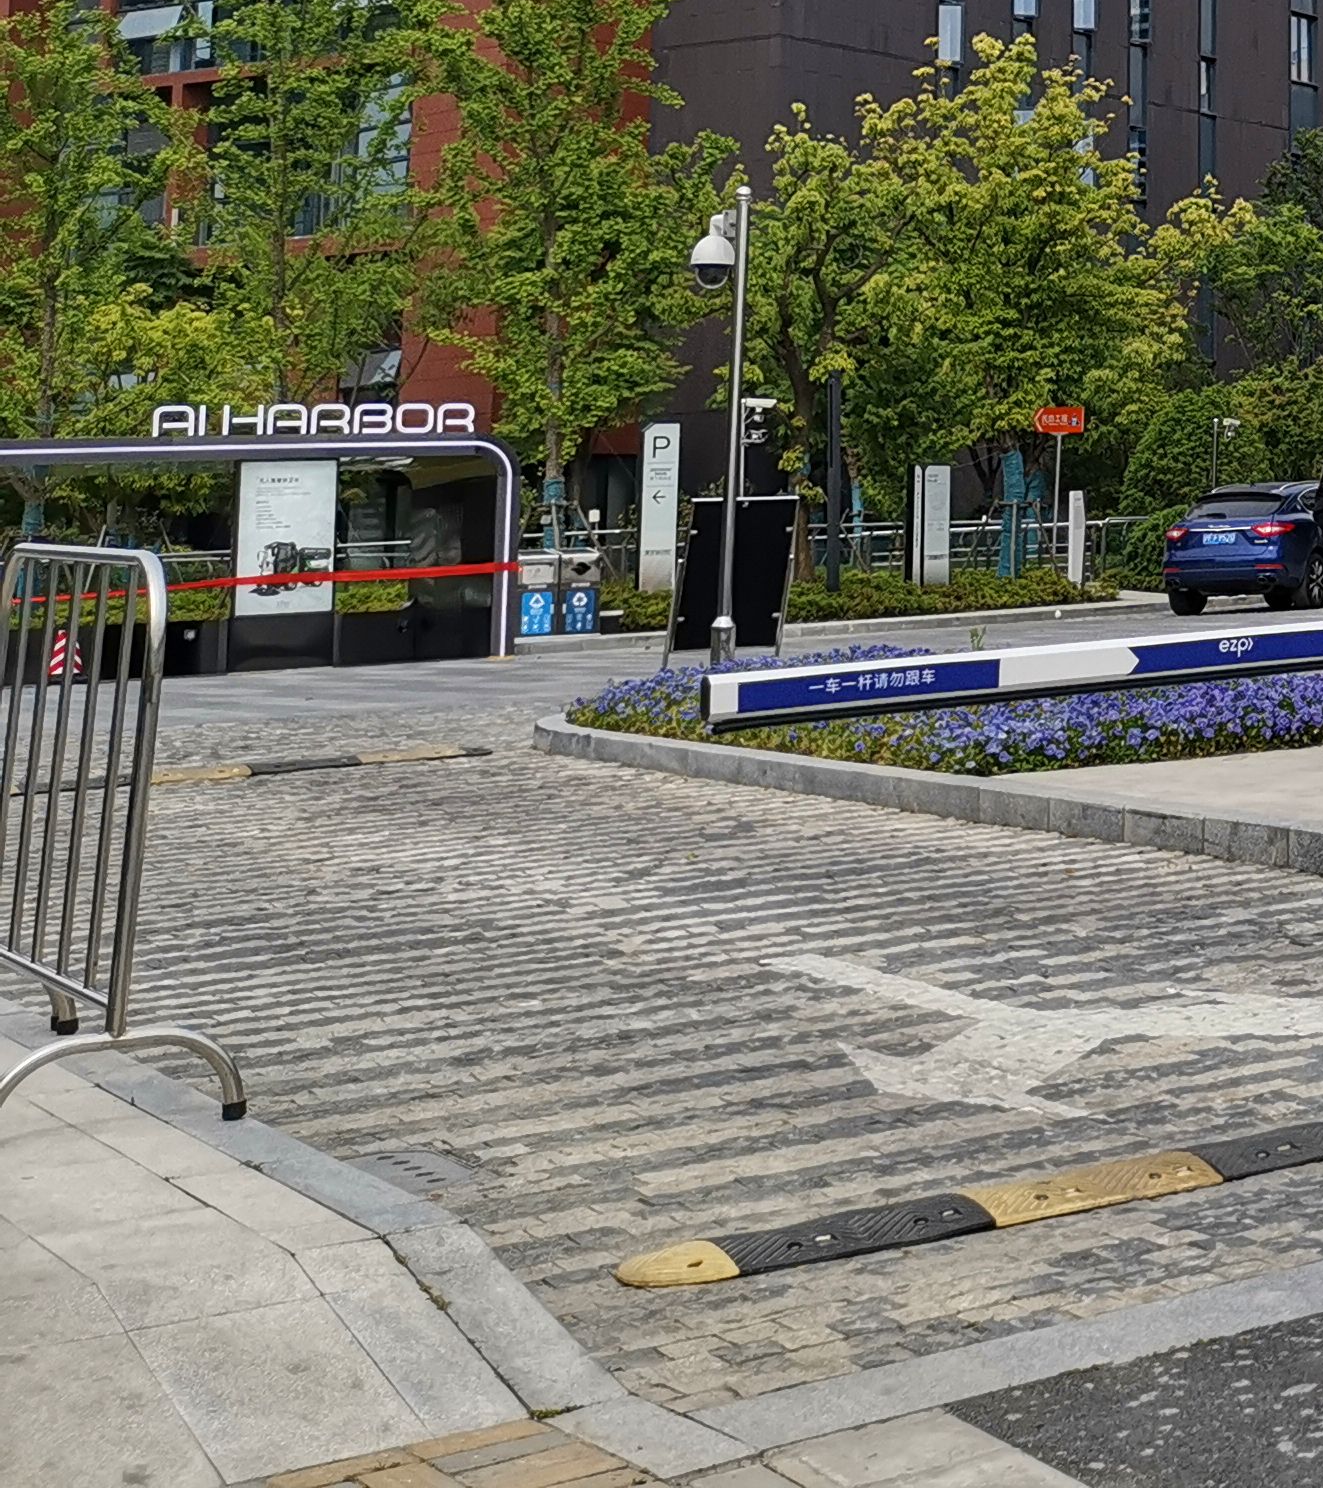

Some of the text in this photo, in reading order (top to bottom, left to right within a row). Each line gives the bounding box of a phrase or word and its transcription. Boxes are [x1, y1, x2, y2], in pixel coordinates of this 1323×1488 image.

[152, 403, 475, 437] AI HARBOR
[652, 435, 671, 459] P
[808, 668, 936, 695] 一车一杆请勿跟车
